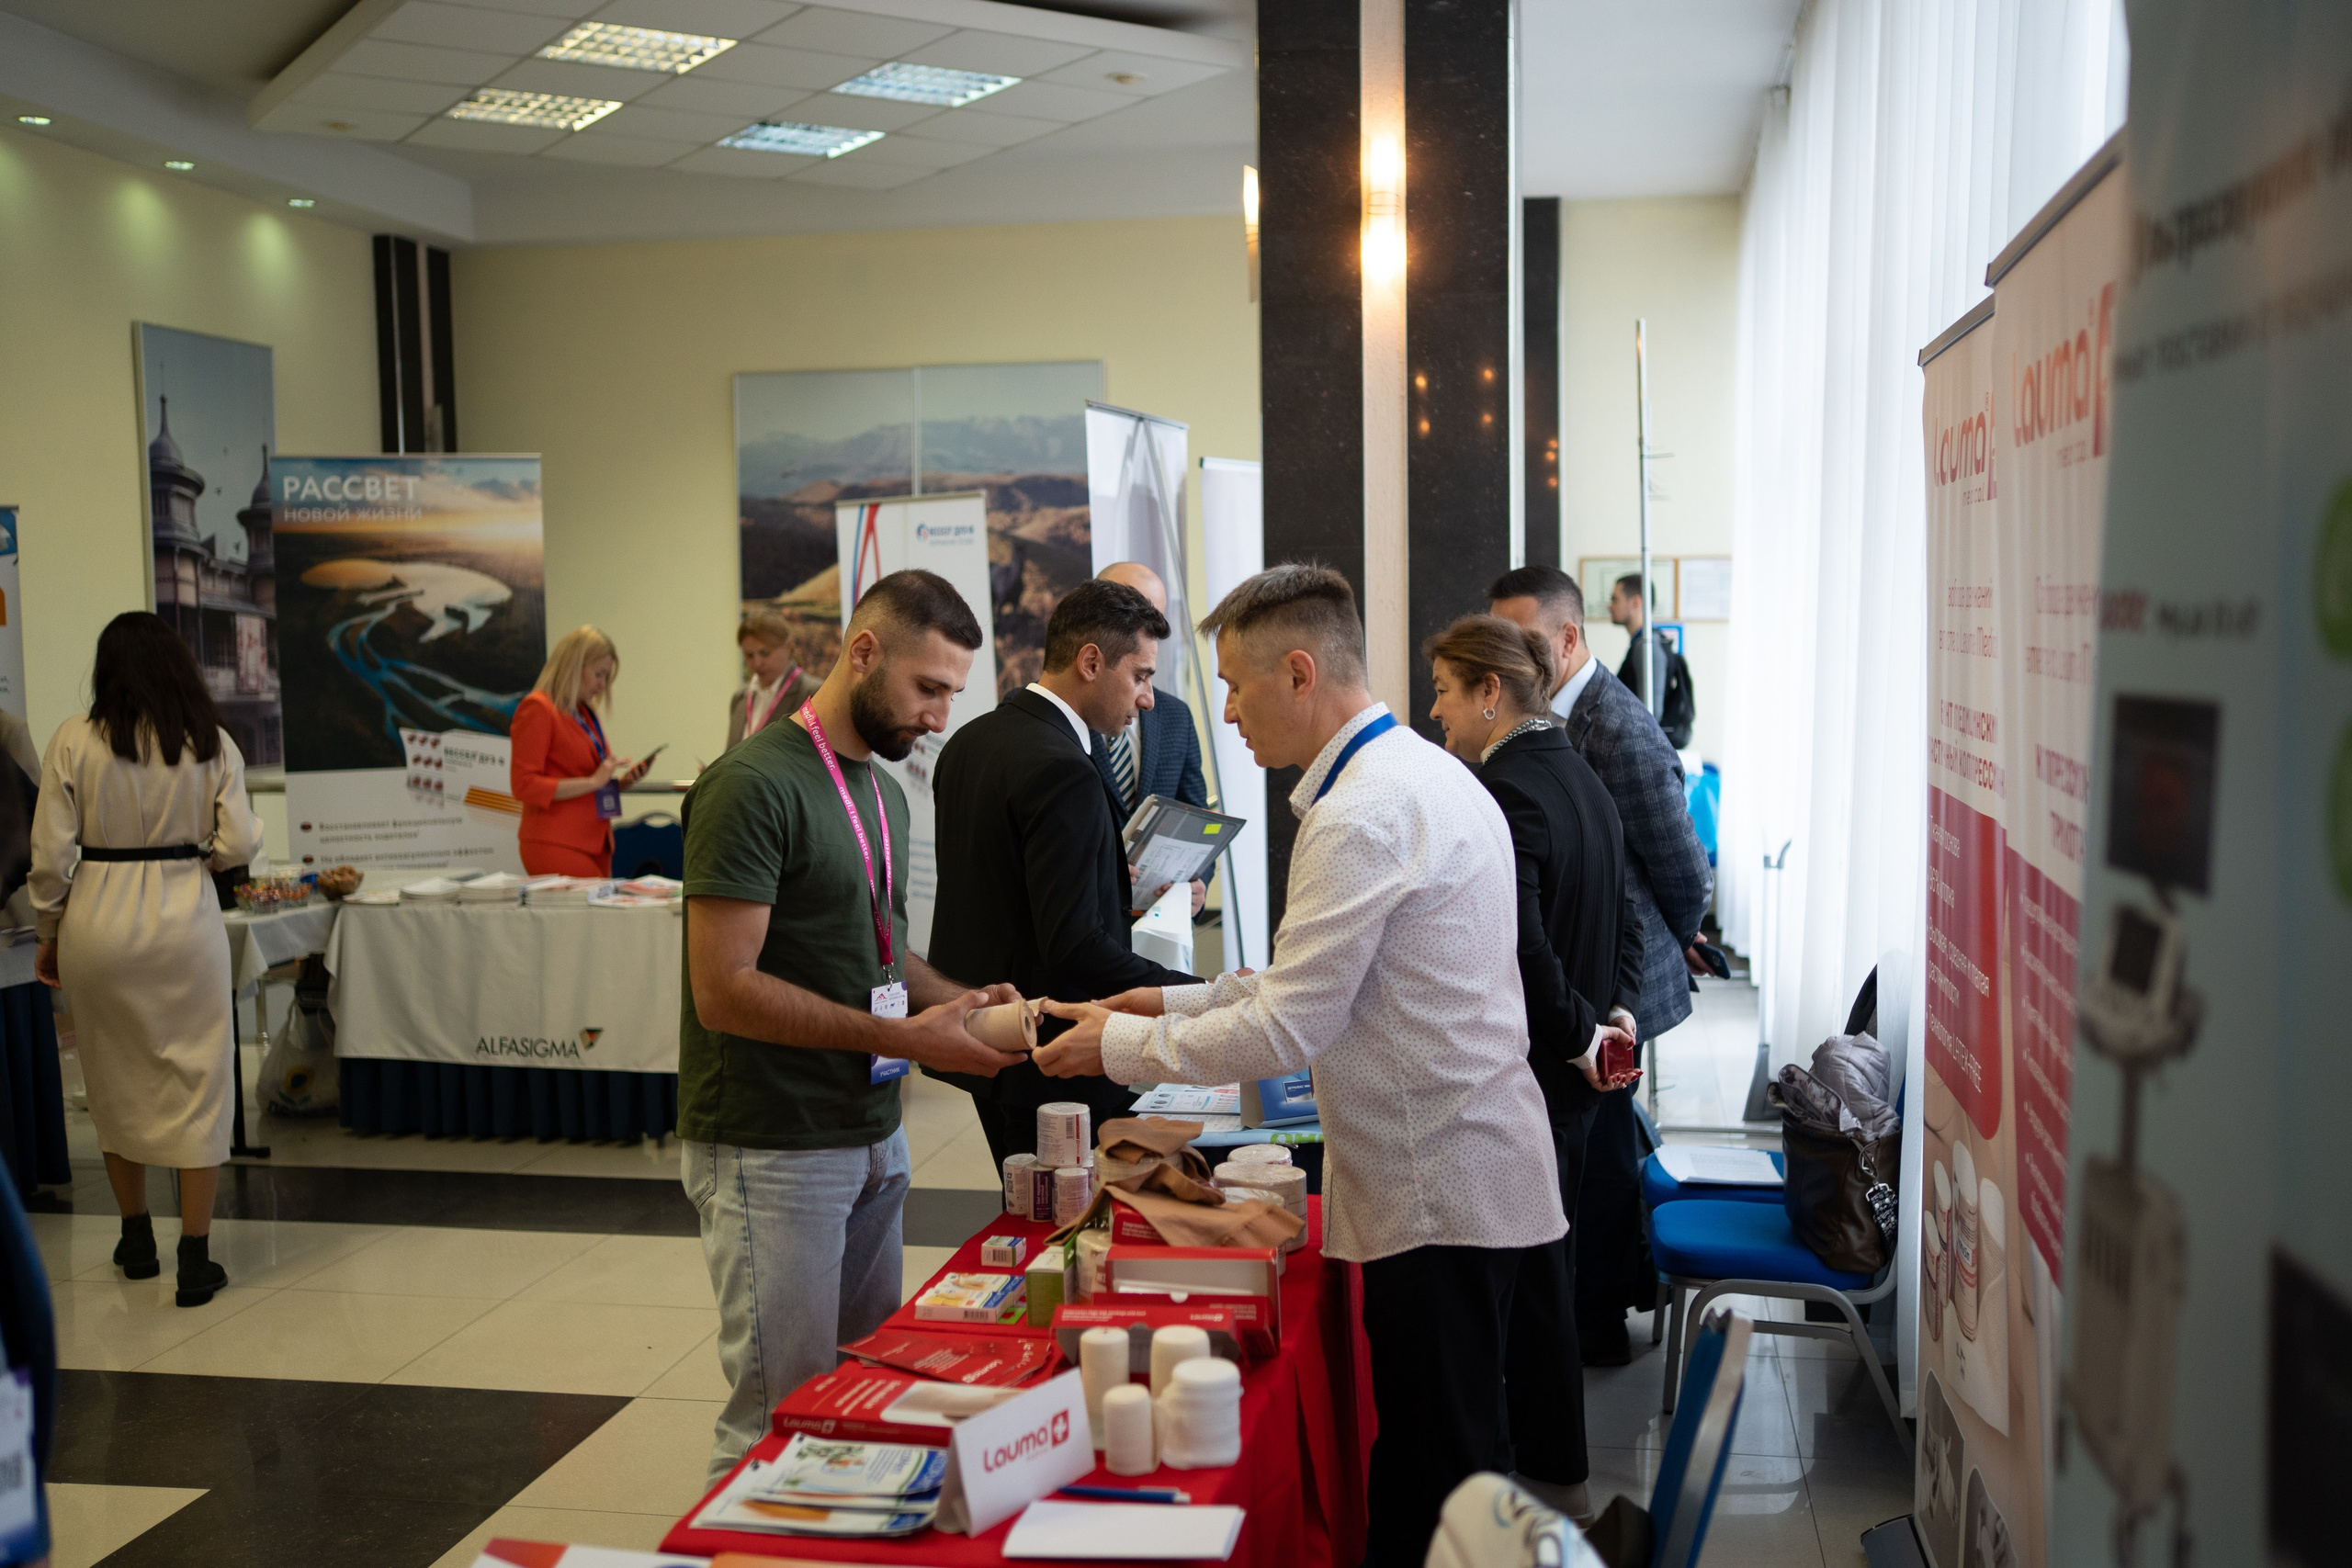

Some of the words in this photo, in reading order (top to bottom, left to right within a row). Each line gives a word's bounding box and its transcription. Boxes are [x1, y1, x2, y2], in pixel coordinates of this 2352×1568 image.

[2012, 329, 2089, 448] Lauma
[1934, 412, 1986, 487] Lauma
[283, 475, 420, 502] РАССВЕТ
[284, 502, 349, 523] НОВОЙ
[356, 506, 422, 522] ЖИЗНИ
[811, 726, 824, 742] feel
[819, 742, 836, 771] better.
[840, 786, 854, 810] medi.
[851, 815, 862, 832] feel
[858, 832, 870, 863] better.
[475, 1036, 581, 1059] ALFASIGMA
[879, 1066, 901, 1078] УЧАСТНИК
[784, 1416, 822, 1431] Lauma
[983, 1426, 1048, 1473] Lauma
